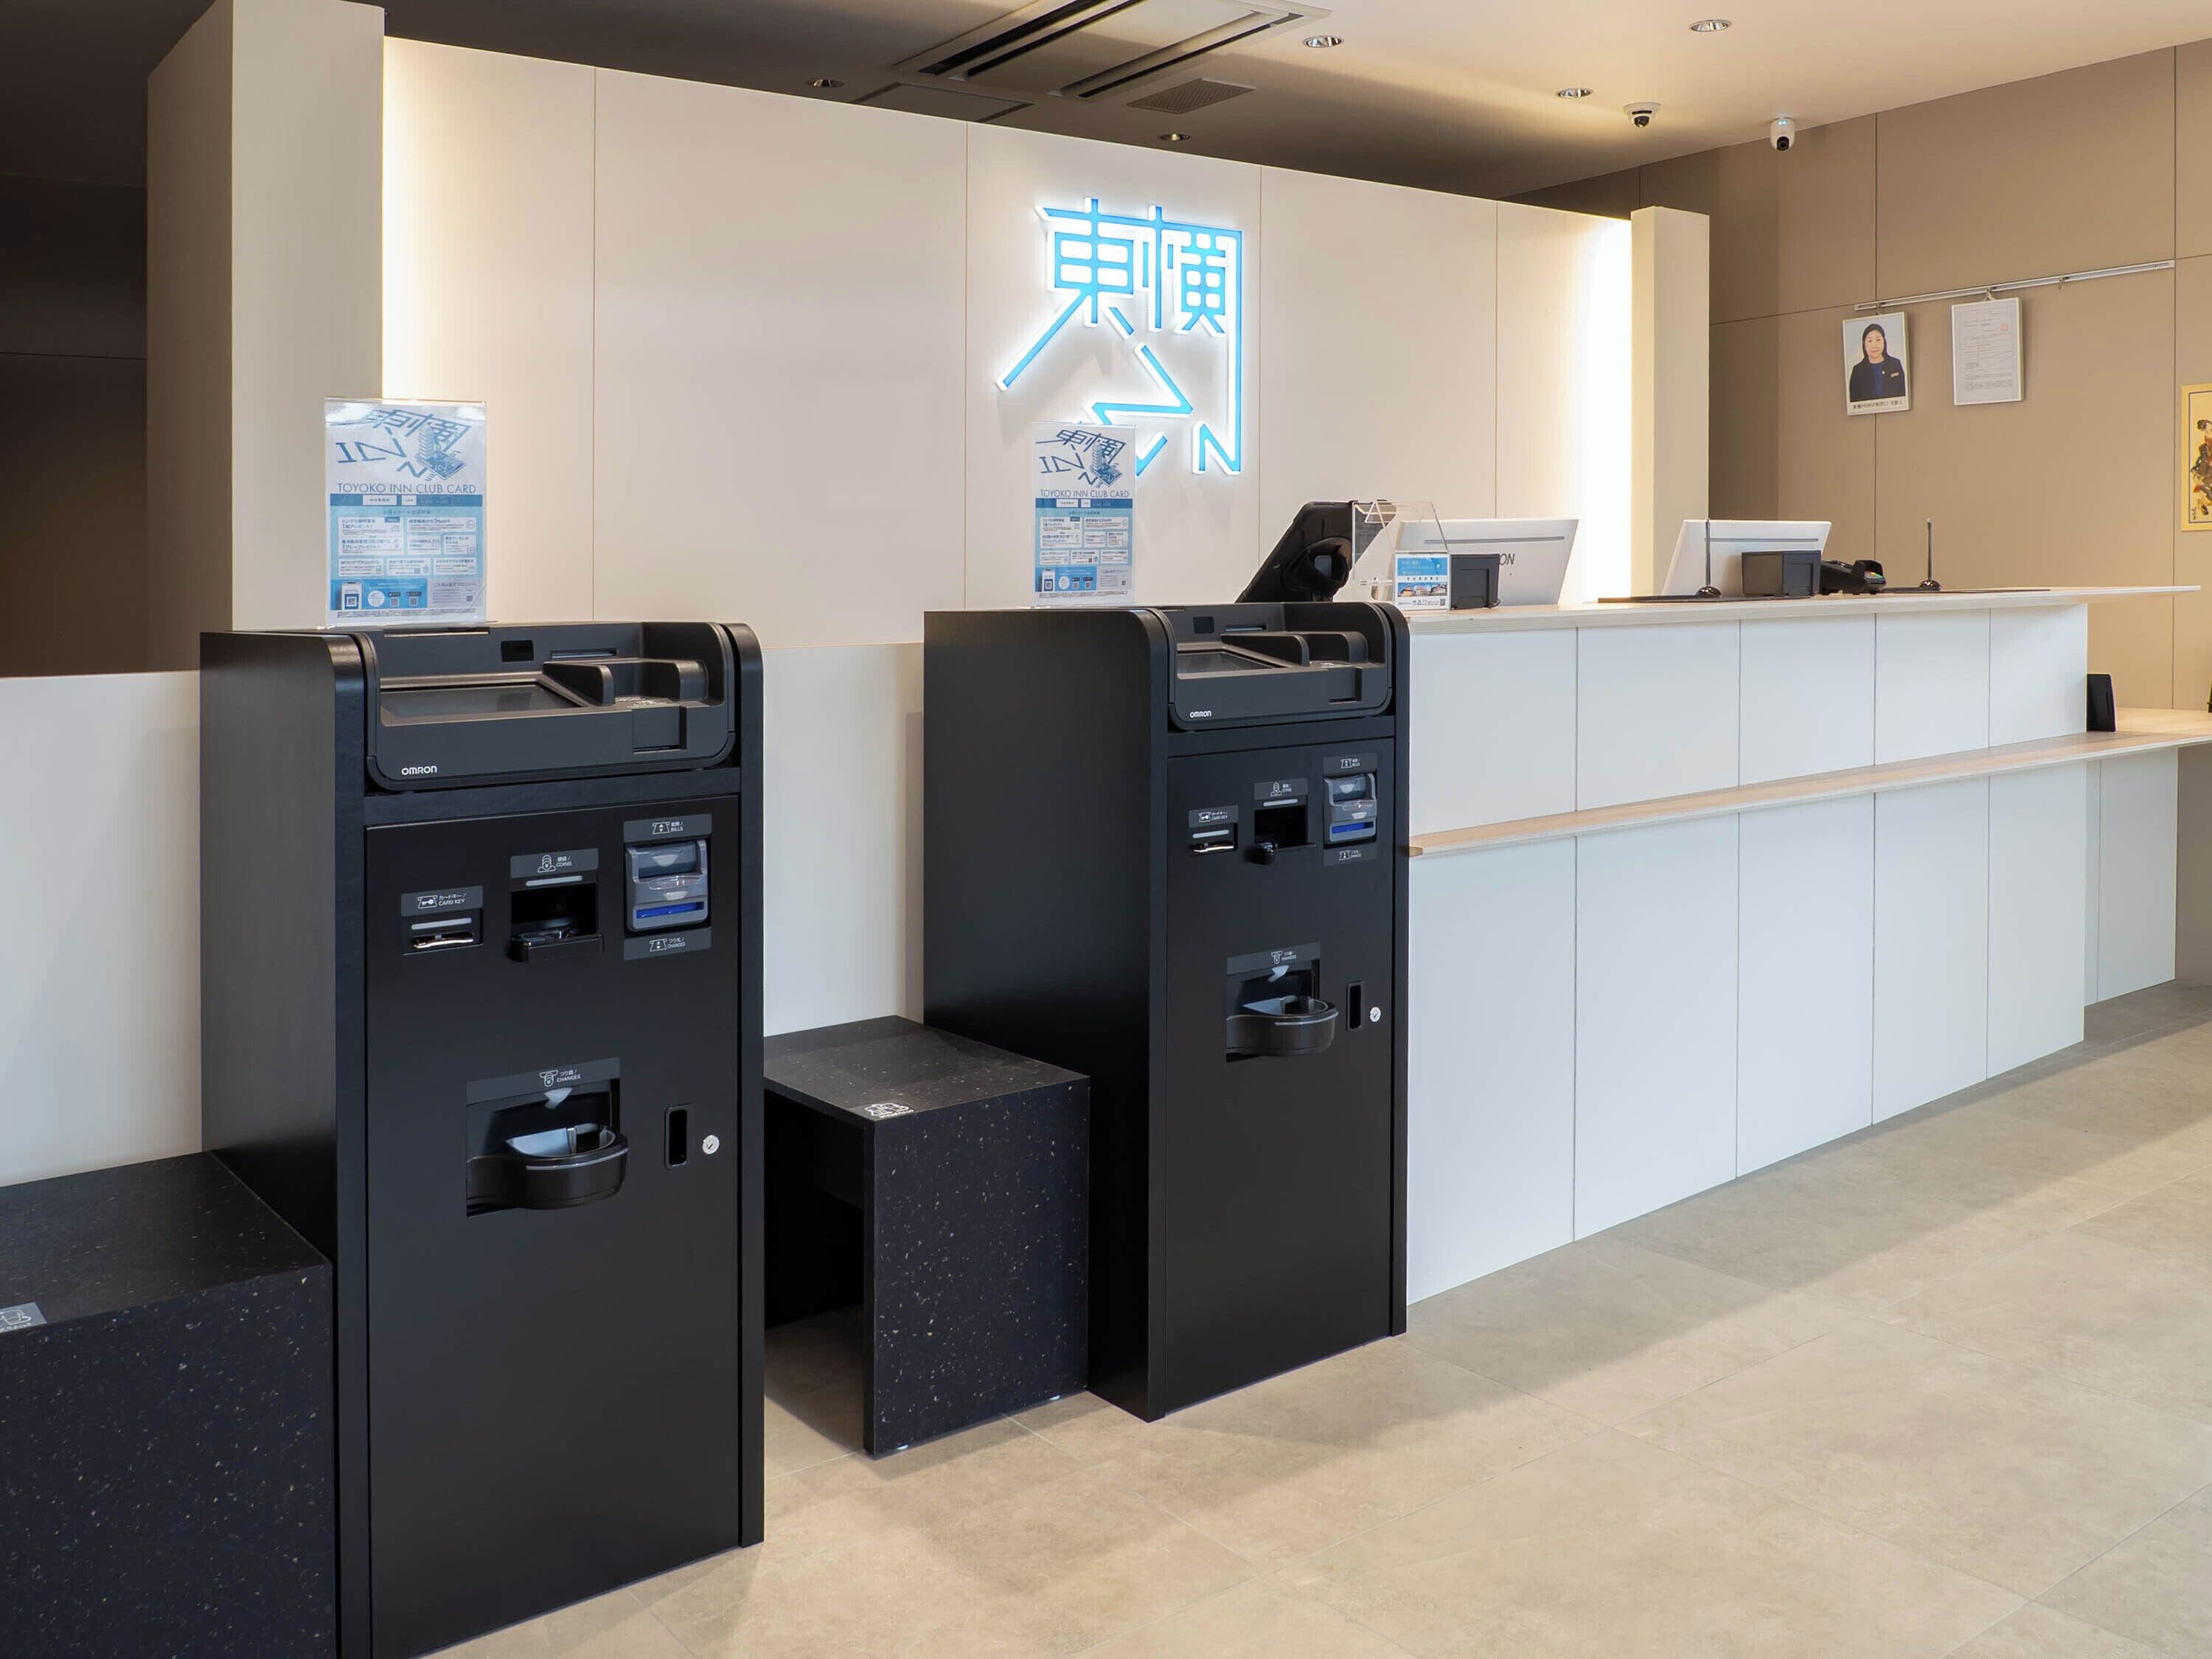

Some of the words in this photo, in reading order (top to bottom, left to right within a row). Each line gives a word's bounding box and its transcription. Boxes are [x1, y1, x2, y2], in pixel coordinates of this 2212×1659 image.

[338, 483, 386, 493] TOYOKO
[389, 484, 412, 493] INN
[416, 484, 443, 493] CLUB
[447, 484, 476, 493] CARD
[1040, 489, 1071, 497] TOYOKO
[1090, 490, 1108, 498] CLUB
[556, 1074, 581, 1082] CHANGES
